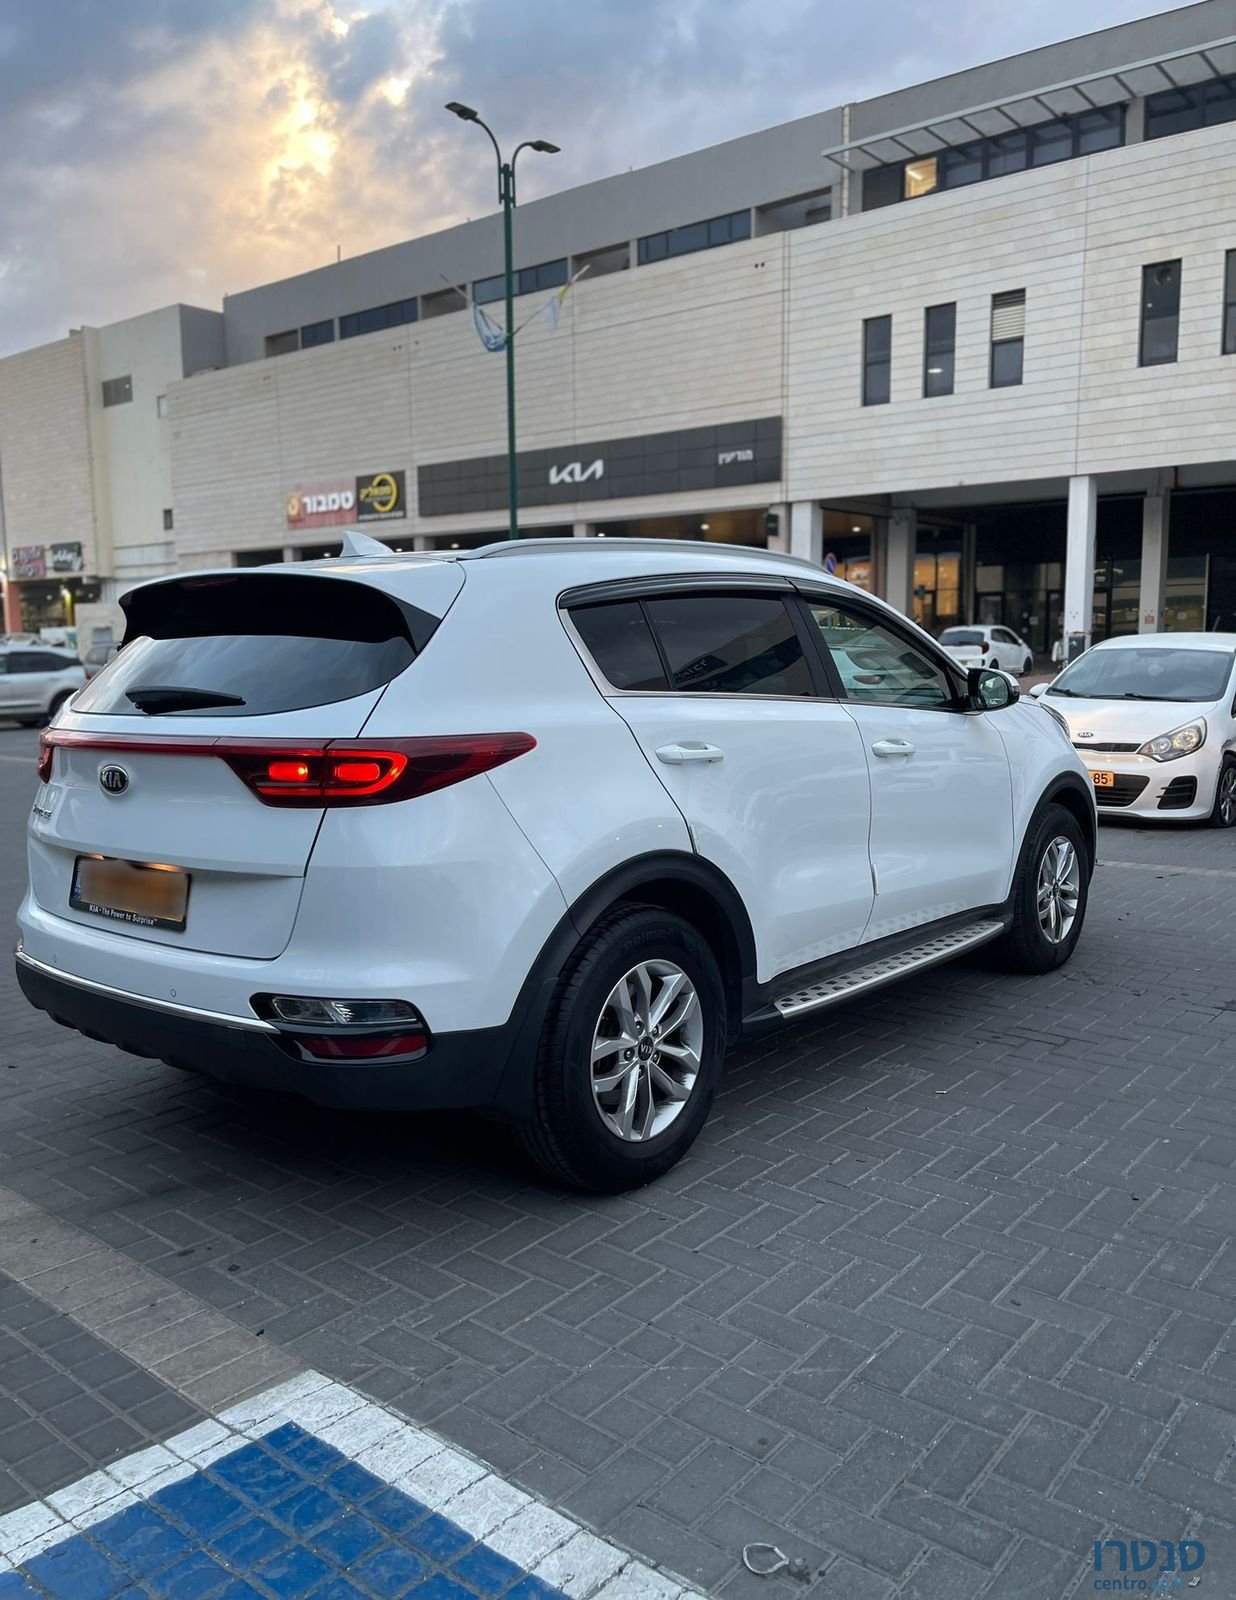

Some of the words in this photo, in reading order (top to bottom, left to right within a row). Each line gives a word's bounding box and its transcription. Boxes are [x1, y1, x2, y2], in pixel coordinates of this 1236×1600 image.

[549, 458, 604, 485] KIA
[302, 491, 354, 515] טמבור
[102, 772, 122, 788] KIA
[89, 904, 98, 913] KIA
[102, 908, 110, 916] The
[110, 909, 125, 920] Power
